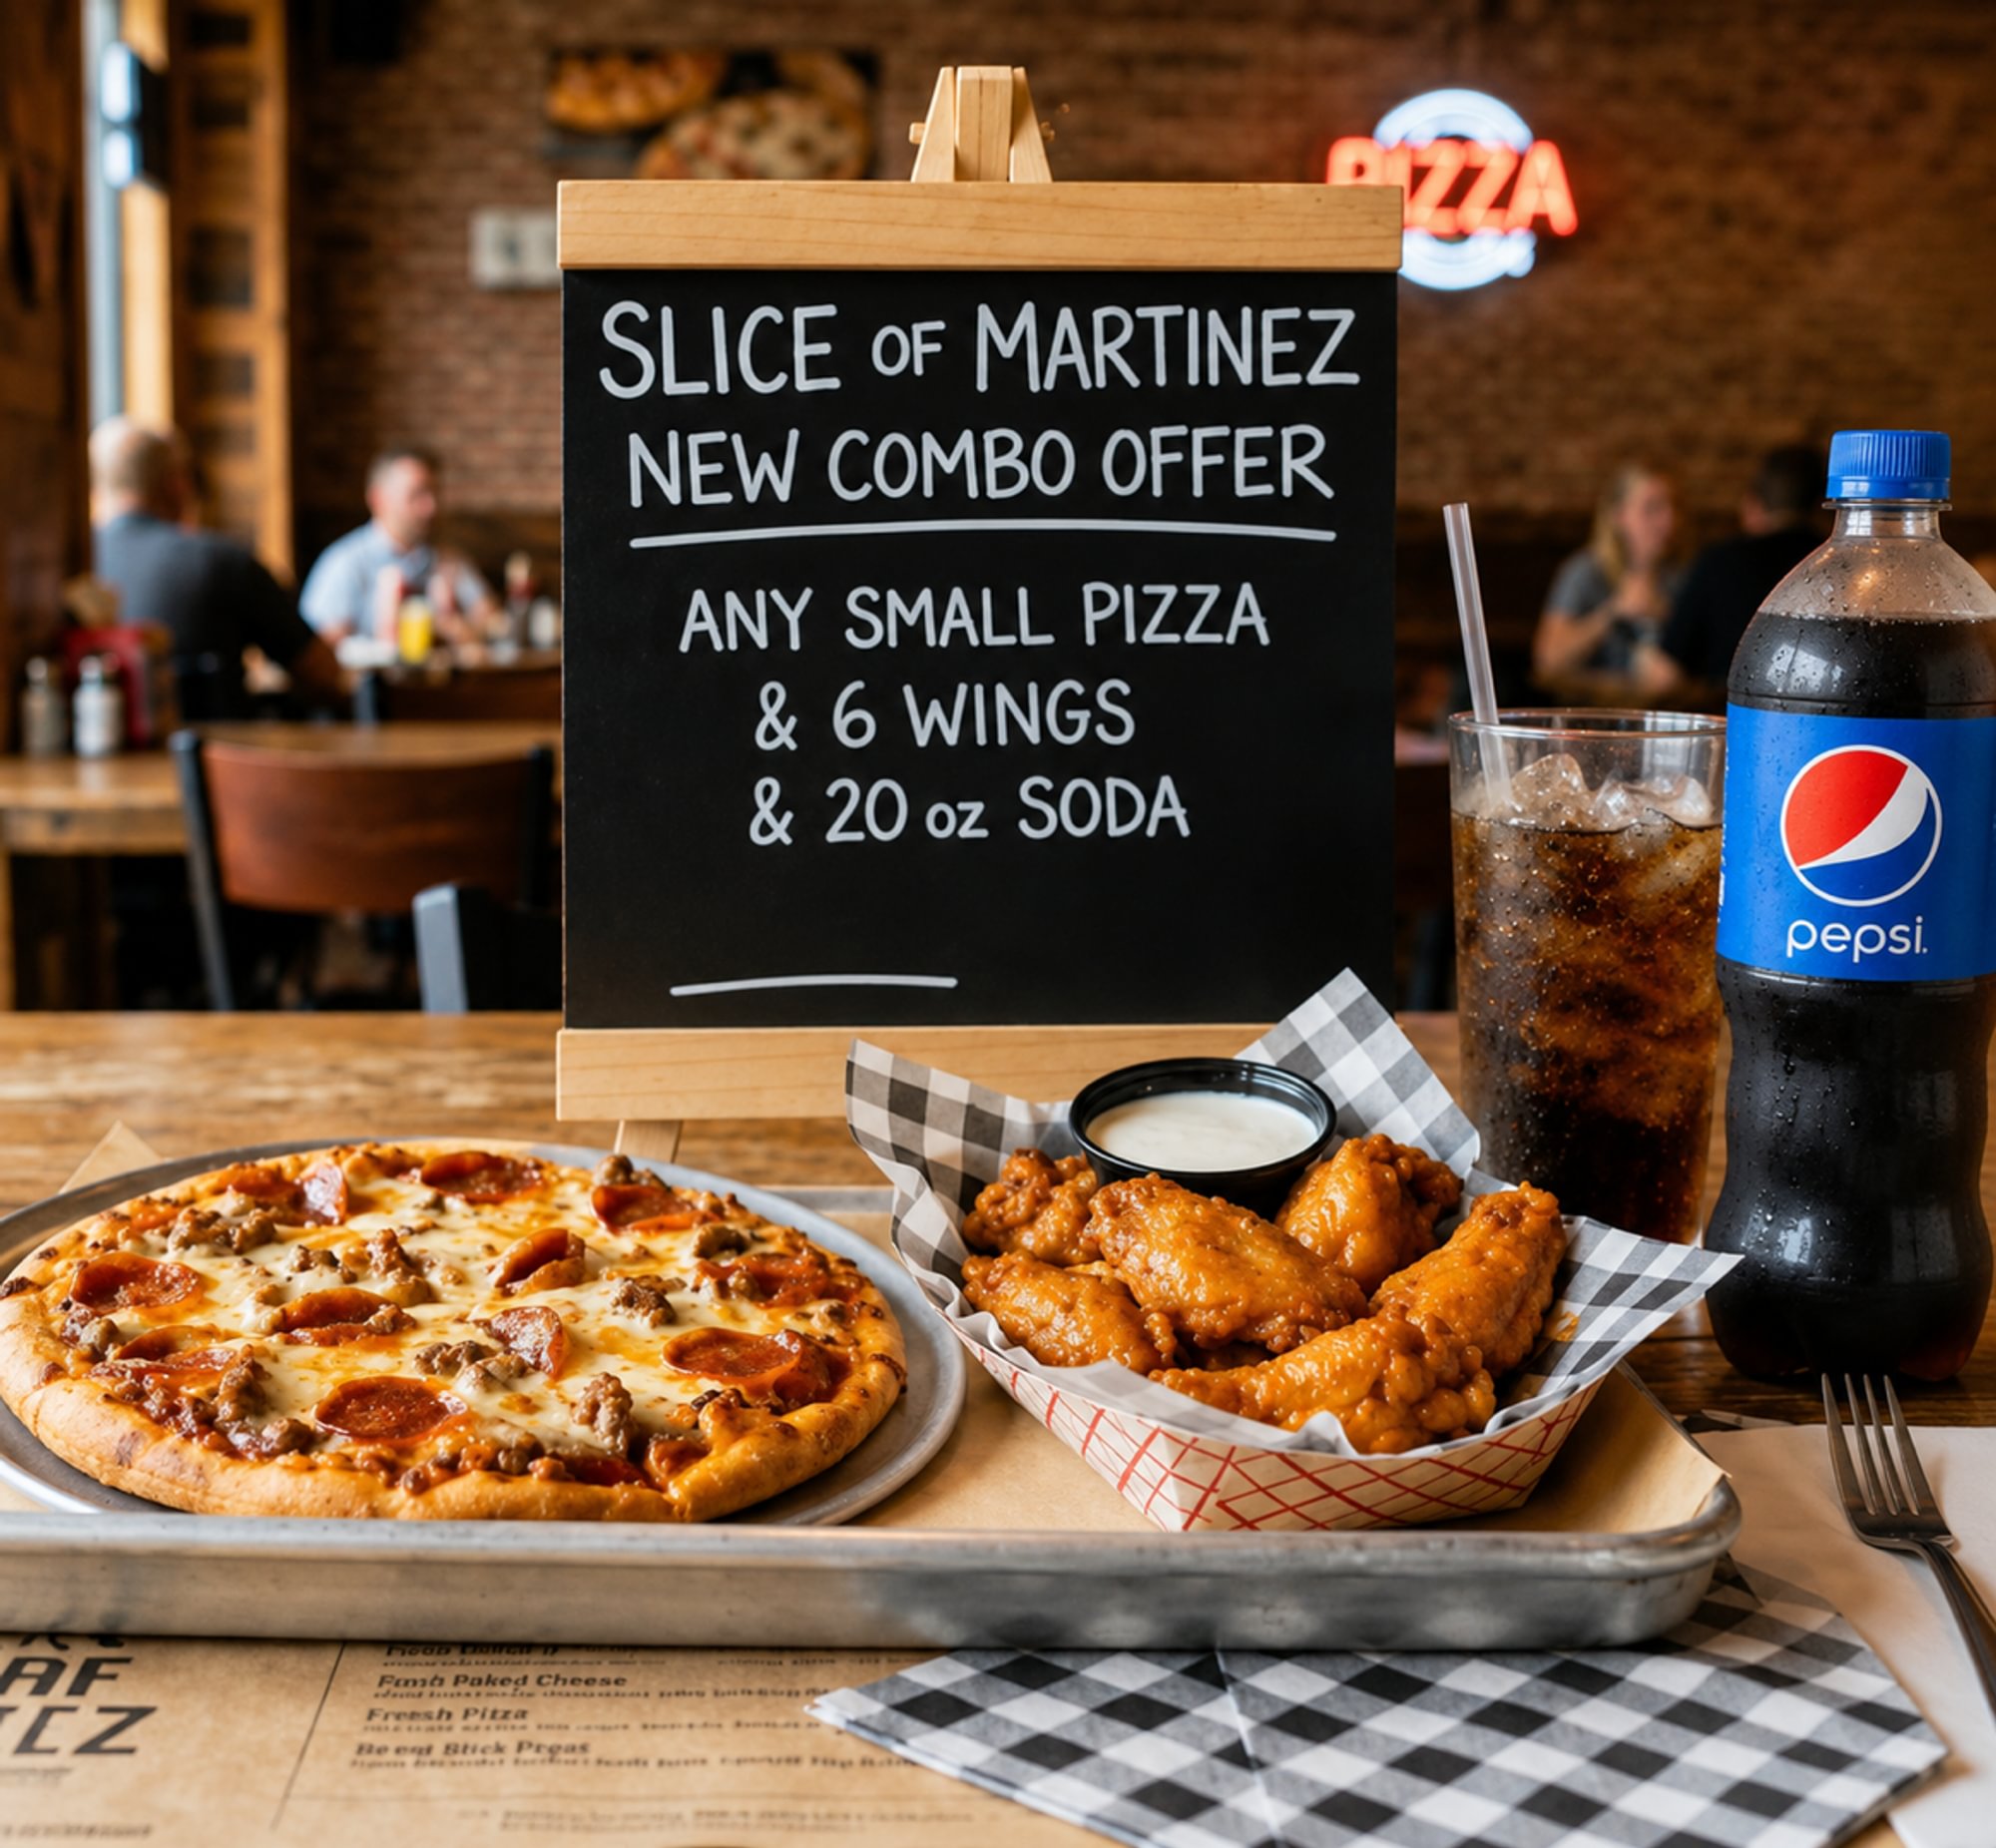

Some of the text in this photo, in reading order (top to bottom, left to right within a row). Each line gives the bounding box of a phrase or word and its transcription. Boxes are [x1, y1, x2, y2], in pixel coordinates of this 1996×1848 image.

[599, 300, 1360, 399] SLICE OF MARTINEZ
[629, 424, 1334, 508] NEW COMBO OFFER
[679, 582, 1270, 654] ANY SMALL PIZZA
[754, 679, 1136, 751] & 6 WINGS
[748, 774, 1192, 846] & 20 oz SODA
[535, 1672, 629, 1688] Cheese
